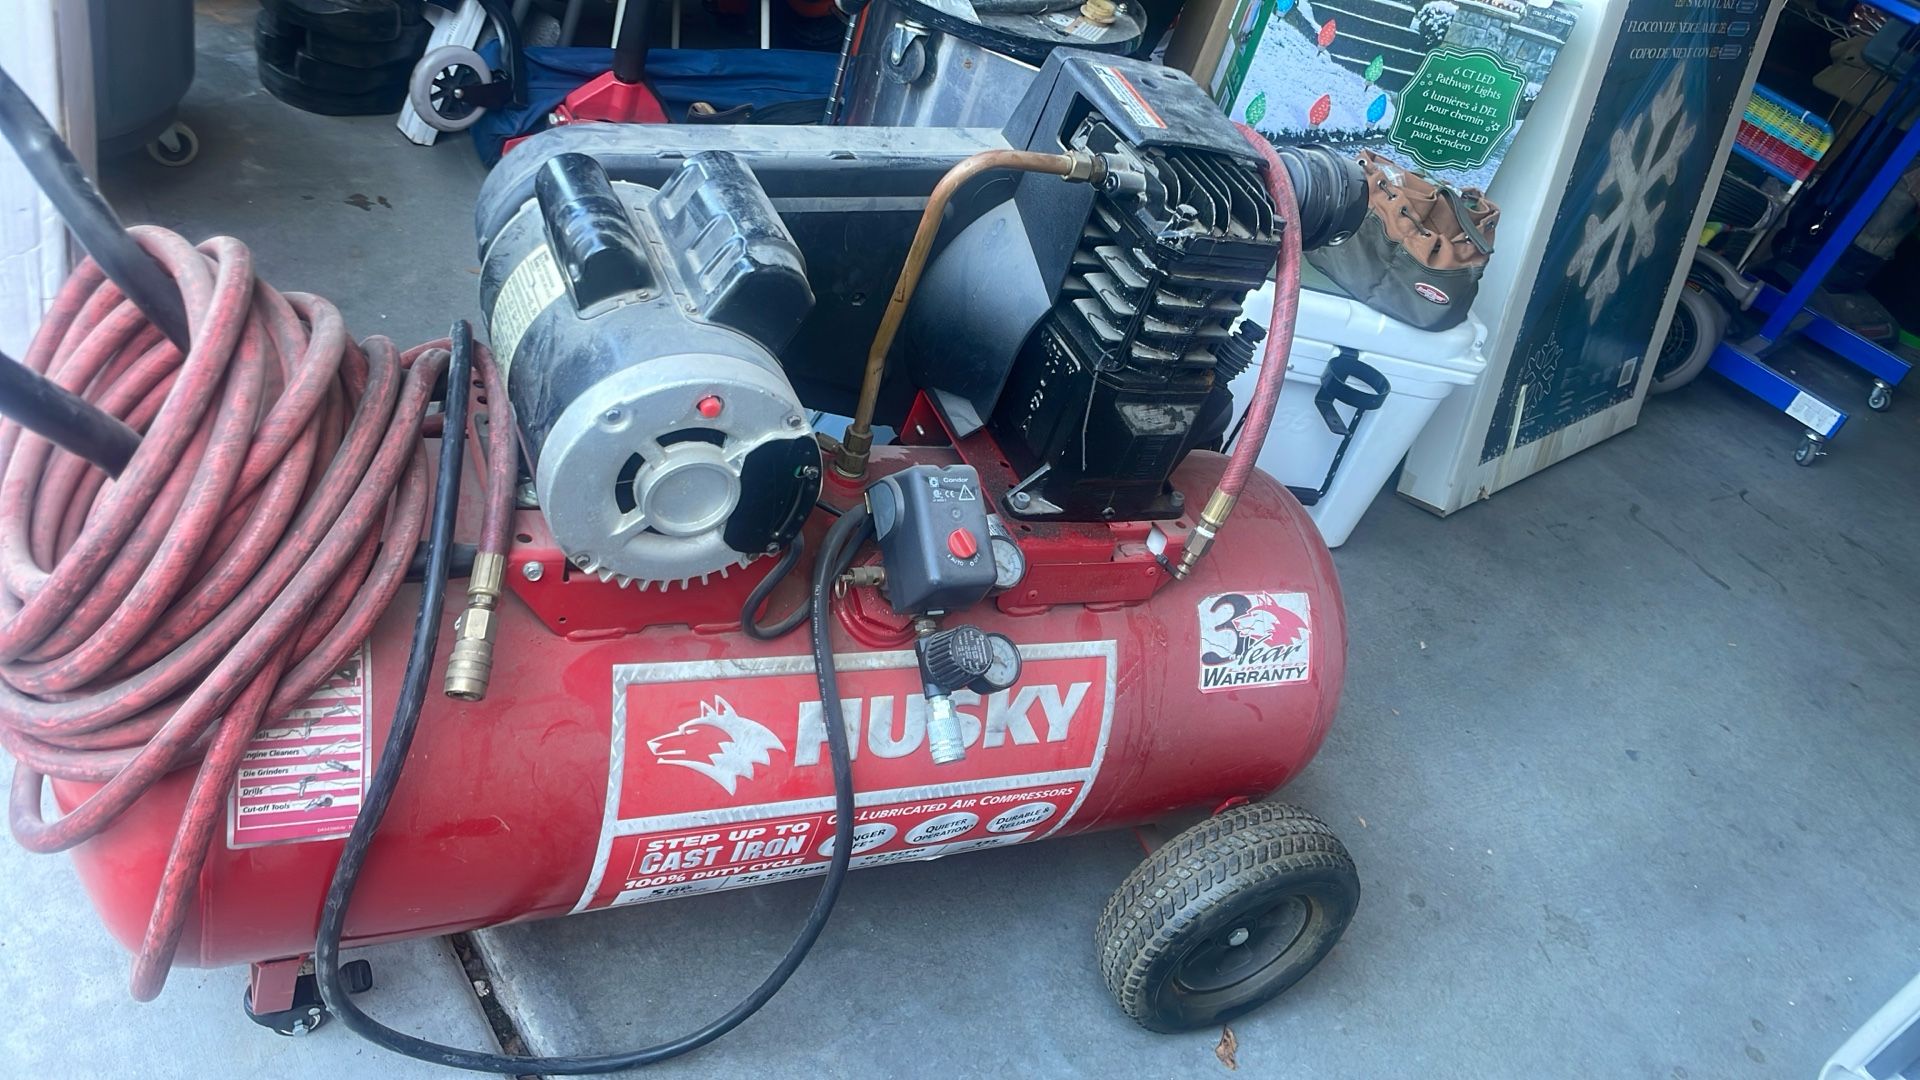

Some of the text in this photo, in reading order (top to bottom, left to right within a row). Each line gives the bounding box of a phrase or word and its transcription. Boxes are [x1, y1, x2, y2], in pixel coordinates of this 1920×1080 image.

[1630, 48, 1655, 59] COPO
[1435, 73, 1502, 100] Pathway Lights
[1453, 67, 1496, 85] 6 CT LED
[1422, 89, 1430, 97] 6
[1430, 90, 1470, 109] lumières
[1480, 104, 1497, 118] DEL
[1424, 103, 1484, 126] pour chemin
[1405, 115, 1489, 145] 6 Lámparas de LED
[1410, 130, 1471, 152] para Sendero
[1202, 593, 1252, 666] 3
[1238, 634, 1303, 665] Year
[1203, 666, 1307, 687] WARRANTY
[795, 682, 1092, 767] HUSKY
[246, 749, 300, 760] ngine Cleaners
[257, 768, 288, 776] Grinders
[242, 788, 263, 796] Drills
[950, 799, 977, 811] AIR
[980, 787, 1075, 806] COMPRESSORS
[242, 803, 290, 813] Cut-off Tools
[995, 810, 1039, 825] DURABLE
[925, 819, 967, 833] QUIETER
[998, 816, 1042, 831] RELIABLE
[646, 822, 811, 852] STEP UP TO
[639, 835, 807, 875] CAST IRON
[625, 873, 686, 890] 100%
[692, 864, 747, 880] DUTY
[749, 857, 805, 872] CYCLE
